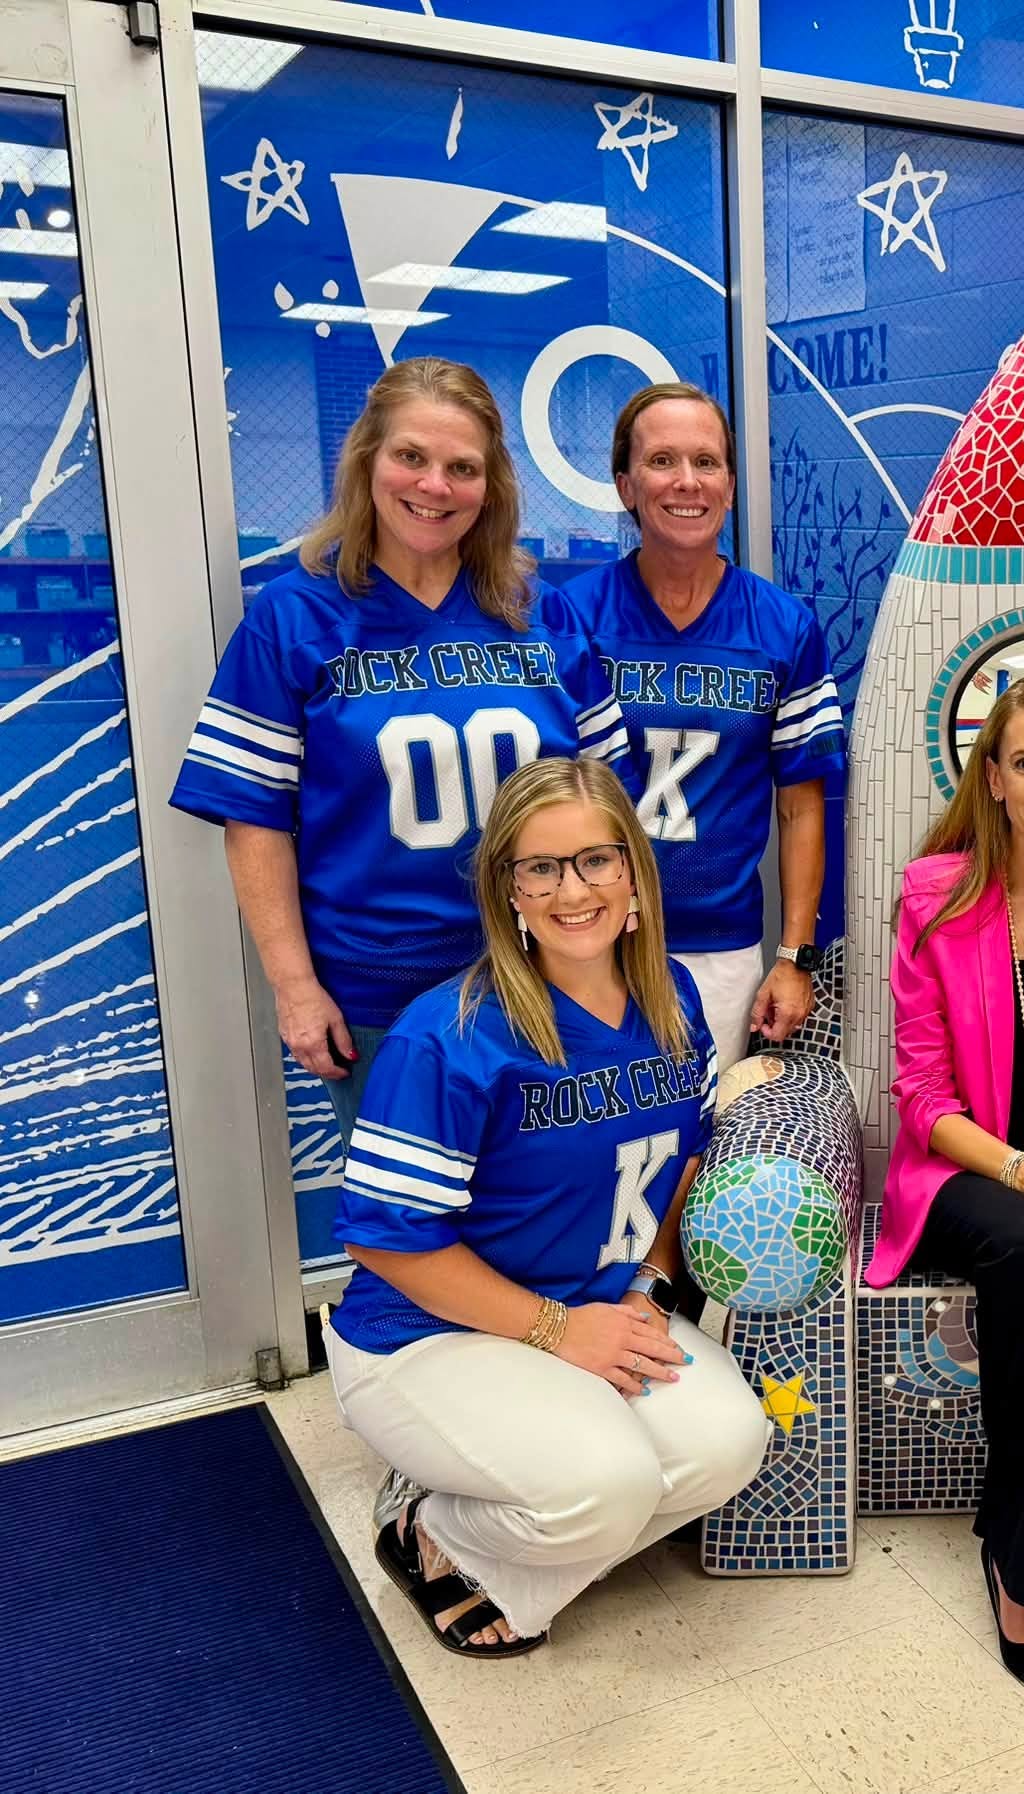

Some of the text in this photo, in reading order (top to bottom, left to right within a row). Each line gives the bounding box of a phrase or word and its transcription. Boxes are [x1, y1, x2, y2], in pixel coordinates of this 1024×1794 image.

[636, 727, 720, 842] K
[519, 1065, 629, 1131] ROCK
[596, 1128, 680, 1271] K
